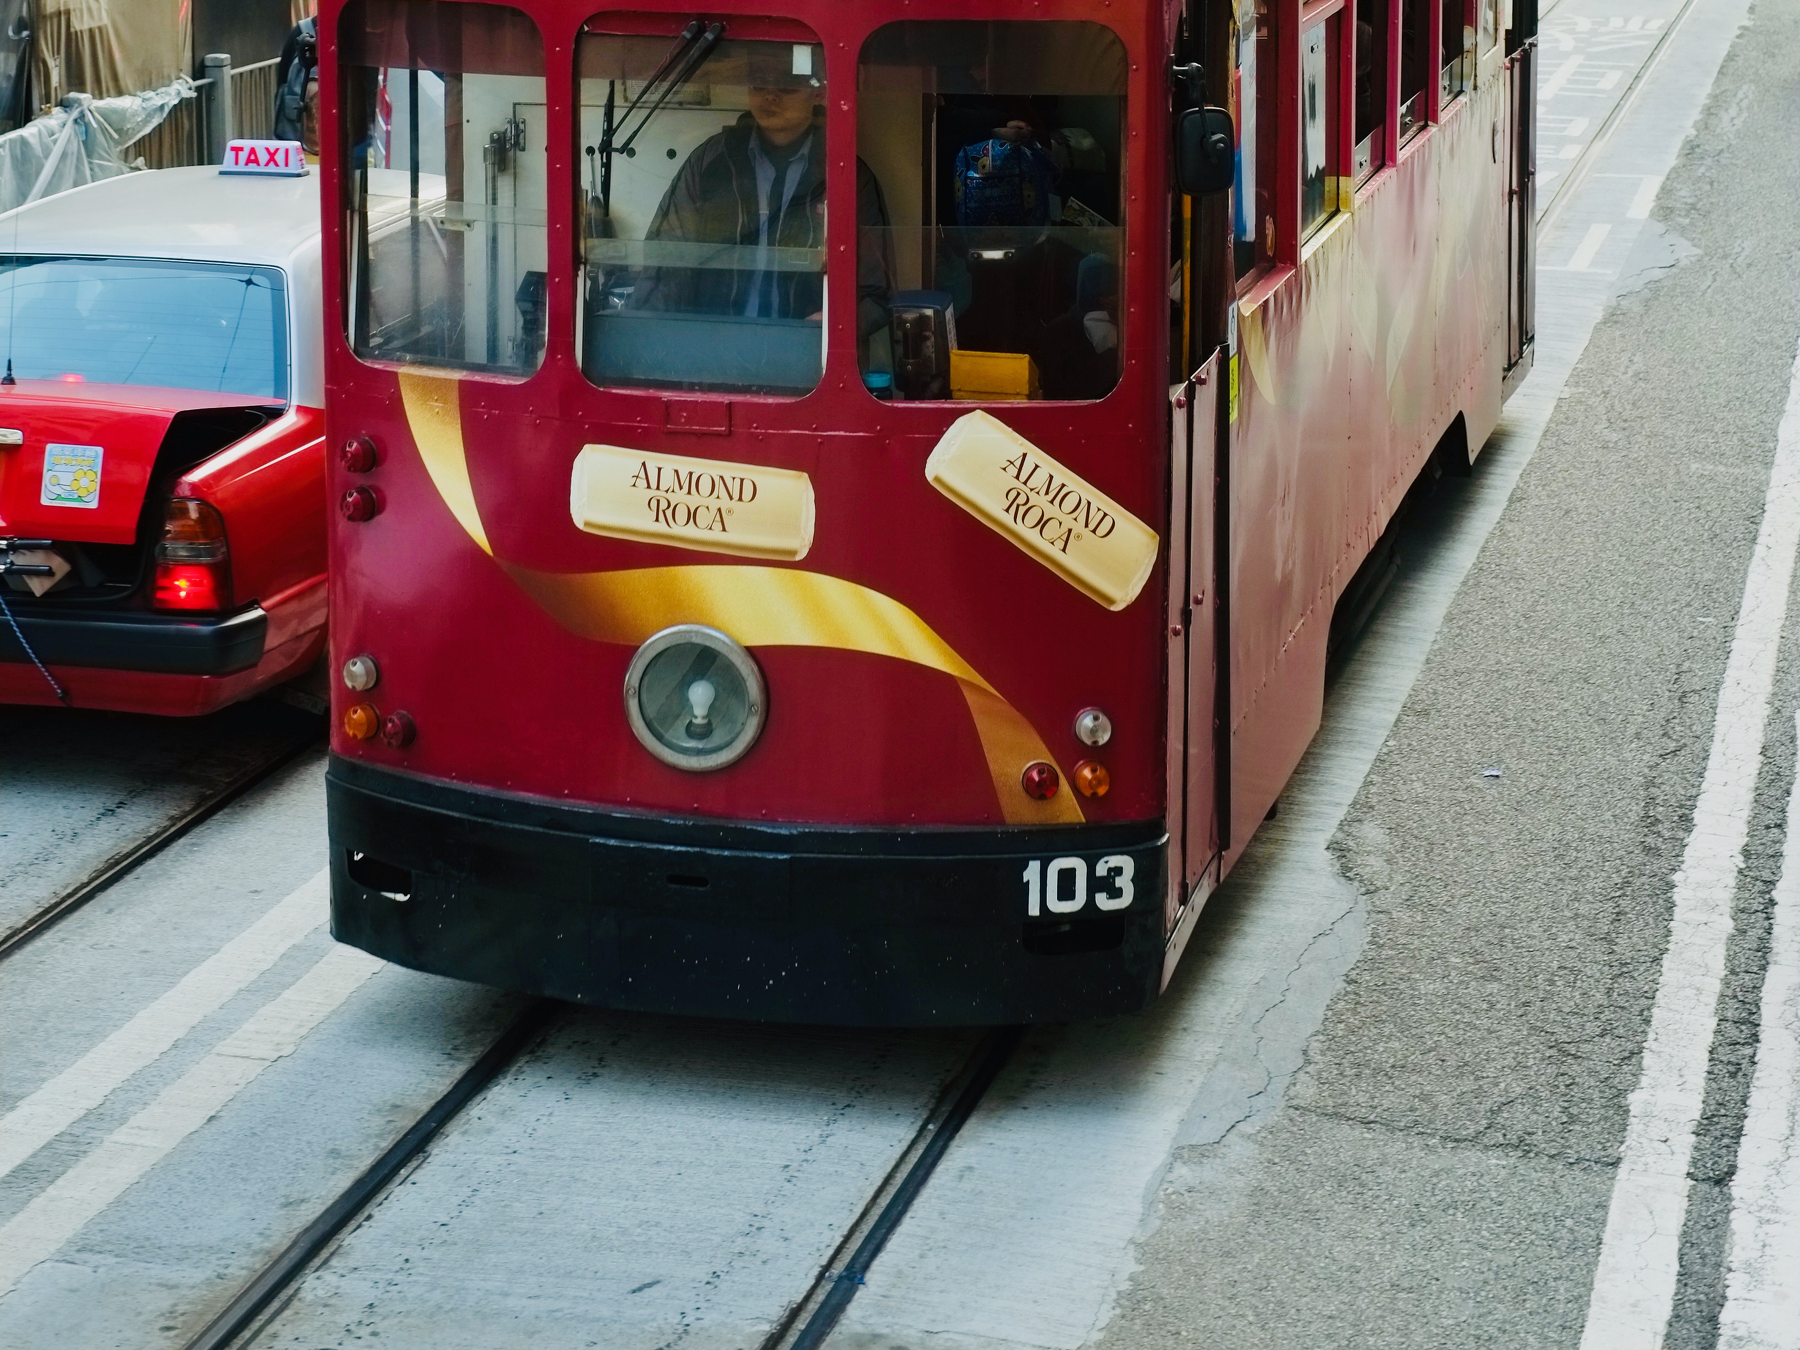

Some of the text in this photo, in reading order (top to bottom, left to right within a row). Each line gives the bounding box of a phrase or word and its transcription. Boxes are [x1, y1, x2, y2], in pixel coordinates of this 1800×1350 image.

[230, 146, 289, 167] TAXI
[629, 460, 758, 503] ALMOND
[999, 452, 1116, 539] ALMOND
[1022, 854, 1135, 917] 103
